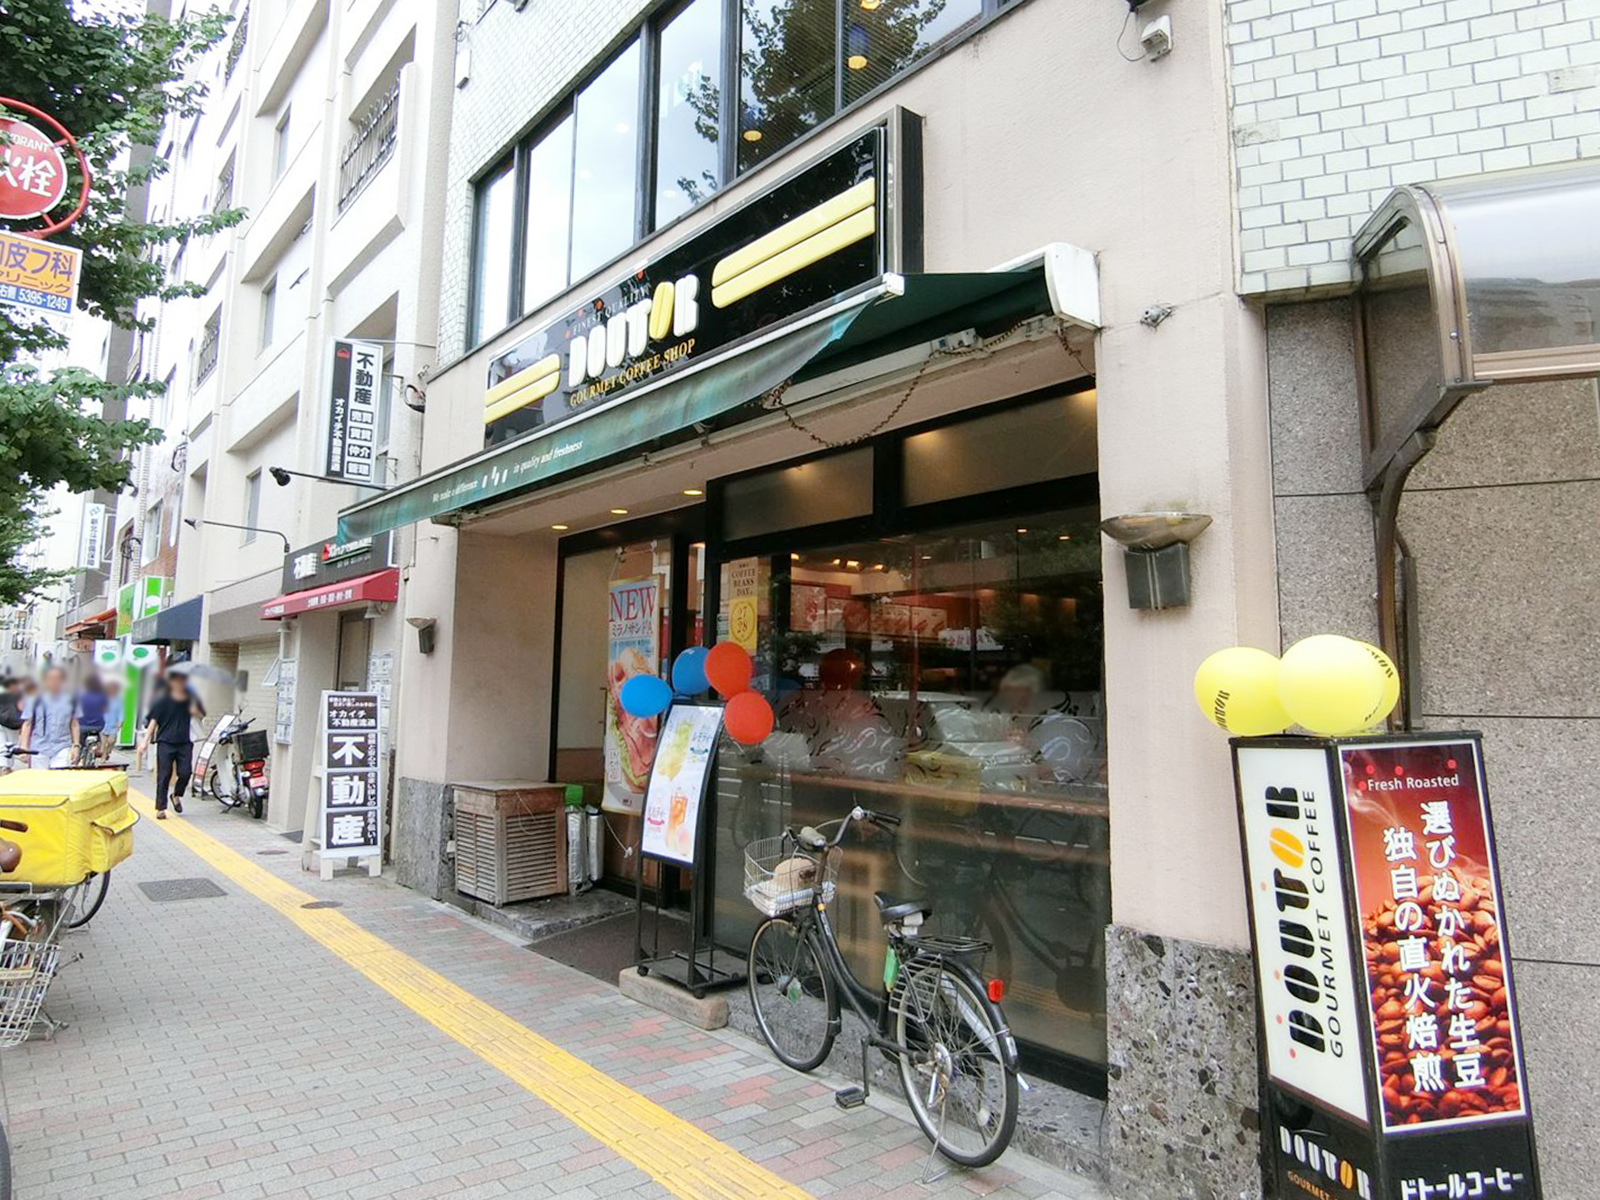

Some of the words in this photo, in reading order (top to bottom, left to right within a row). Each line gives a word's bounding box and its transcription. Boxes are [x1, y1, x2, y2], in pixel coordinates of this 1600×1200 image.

[0, 240, 73, 282] 皮フ科
[0, 270, 70, 293] リニック
[18, 288, 68, 312] 5395-1249
[569, 274, 699, 388] DOUTOR
[354, 351, 375, 406] 不動産
[570, 374, 618, 407] GOURMET
[619, 354, 661, 385] COFFEE
[663, 338, 696, 363] SHOP
[348, 445, 371, 459] 仲介
[609, 585, 657, 622] NEW
[329, 709, 367, 719] オカイチ
[331, 735, 366, 846] 不動産
[1367, 777, 1403, 791] Fresh
[1406, 774, 1460, 789] Roasted
[1302, 790, 1326, 894] COFFEE
[1264, 785, 1326, 1053] DOUTOR
[1419, 800, 1486, 1088] 選びぬかれた生豆
[1315, 908, 1344, 1058] GOURMET
[1382, 825, 1445, 1093] 独自の直火焙煎
[1279, 1125, 1371, 1199] DOUTOR
[1401, 1167, 1524, 1200] ドトールコーヒー
